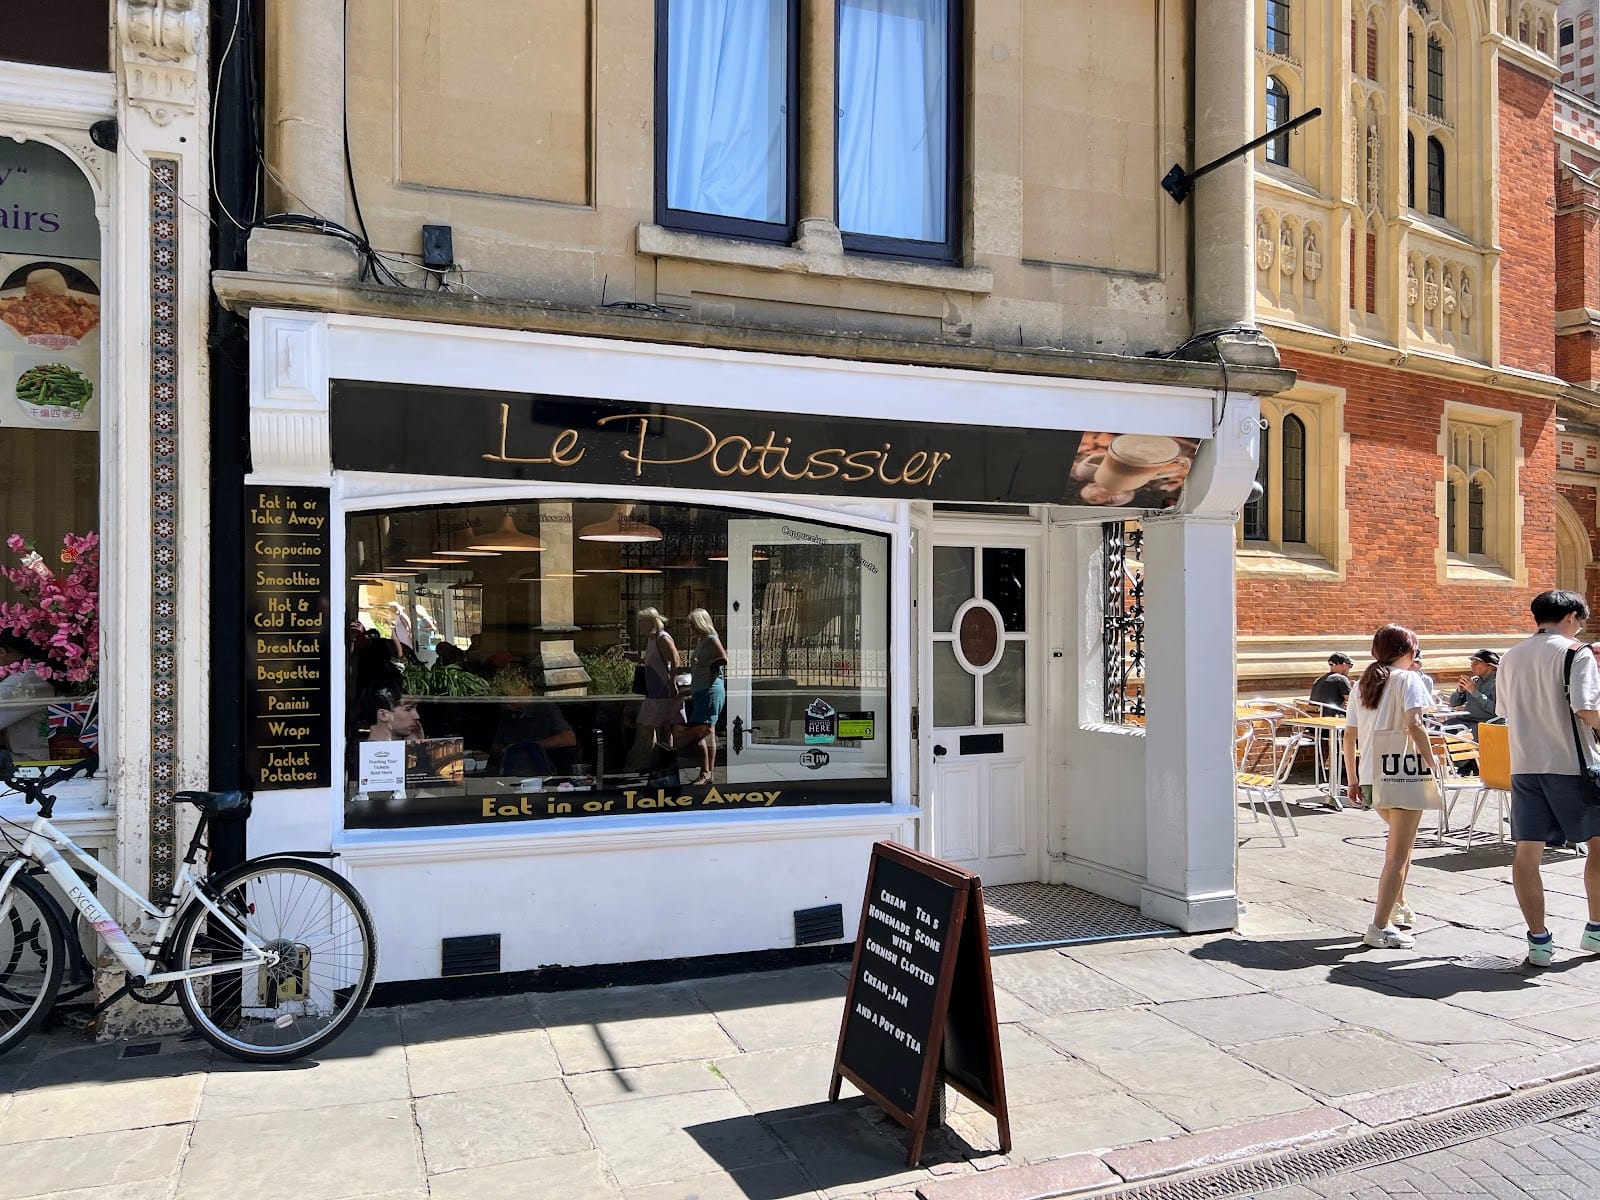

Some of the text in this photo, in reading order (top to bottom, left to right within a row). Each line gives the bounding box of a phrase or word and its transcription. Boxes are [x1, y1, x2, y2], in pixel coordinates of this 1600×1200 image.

[482, 402, 952, 487] Le Patissier
[259, 493, 318, 510] Eat in or
[250, 509, 325, 529] Take Away
[255, 540, 322, 559] Cappucino
[256, 570, 320, 586] Smoothies
[268, 597, 310, 612] Hot &
[254, 611, 323, 628] Cold Food
[257, 638, 320, 654] Breakfast
[257, 665, 320, 684] Baguettes
[268, 695, 310, 711] Paninis
[268, 721, 310, 740] Wraps
[808, 724, 831, 733] HERE
[268, 751, 310, 767] Jacket
[1381, 753, 1432, 776] UCL
[260, 767, 318, 783] Potatoes
[481, 785, 783, 818] Eat in or Take Away
[880, 888, 907, 912] CREAM
[868, 902, 941, 953] HOMEMADE SCONE
[865, 937, 936, 986] CORNISH CLOTTED
[906, 1033, 922, 1055] TEA
